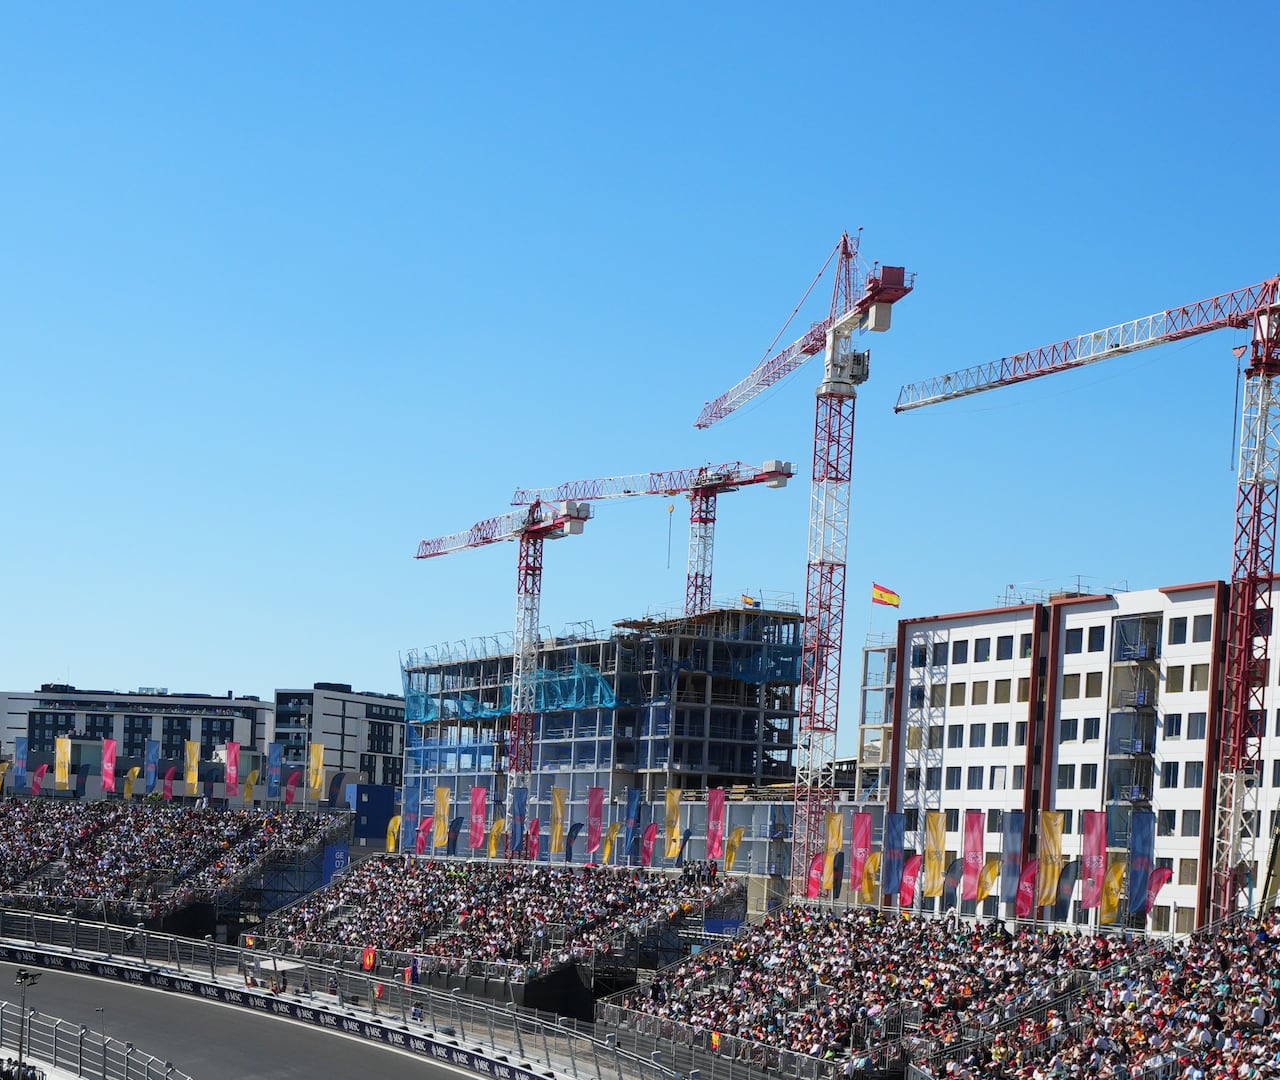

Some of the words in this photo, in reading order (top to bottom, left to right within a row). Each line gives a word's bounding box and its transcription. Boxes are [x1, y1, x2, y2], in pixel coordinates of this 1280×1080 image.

[22, 951, 37, 962] MSC
[50, 956, 64, 966] MSC
[76, 961, 90, 971] MSC
[104, 965, 118, 976] MSC
[130, 970, 143, 981] MSC
[155, 975, 169, 986] MSC
[180, 981, 193, 991] MSC
[205, 986, 218, 997] MSC
[229, 992, 243, 1002] MSC
[254, 998, 267, 1008] MSC
[278, 1003, 291, 1014] MSC
[301, 1009, 314, 1020] MSC
[324, 1015, 337, 1026] MSC
[347, 1021, 360, 1032] MSC
[370, 1027, 382, 1039] MSC
[392, 1034, 405, 1045] MSC
[414, 1039, 426, 1051] MSC
[436, 1046, 448, 1058] MSC
[457, 1052, 469, 1065] MSC
[479, 1059, 490, 1072] MSC
[499, 1066, 510, 1079] MSC
